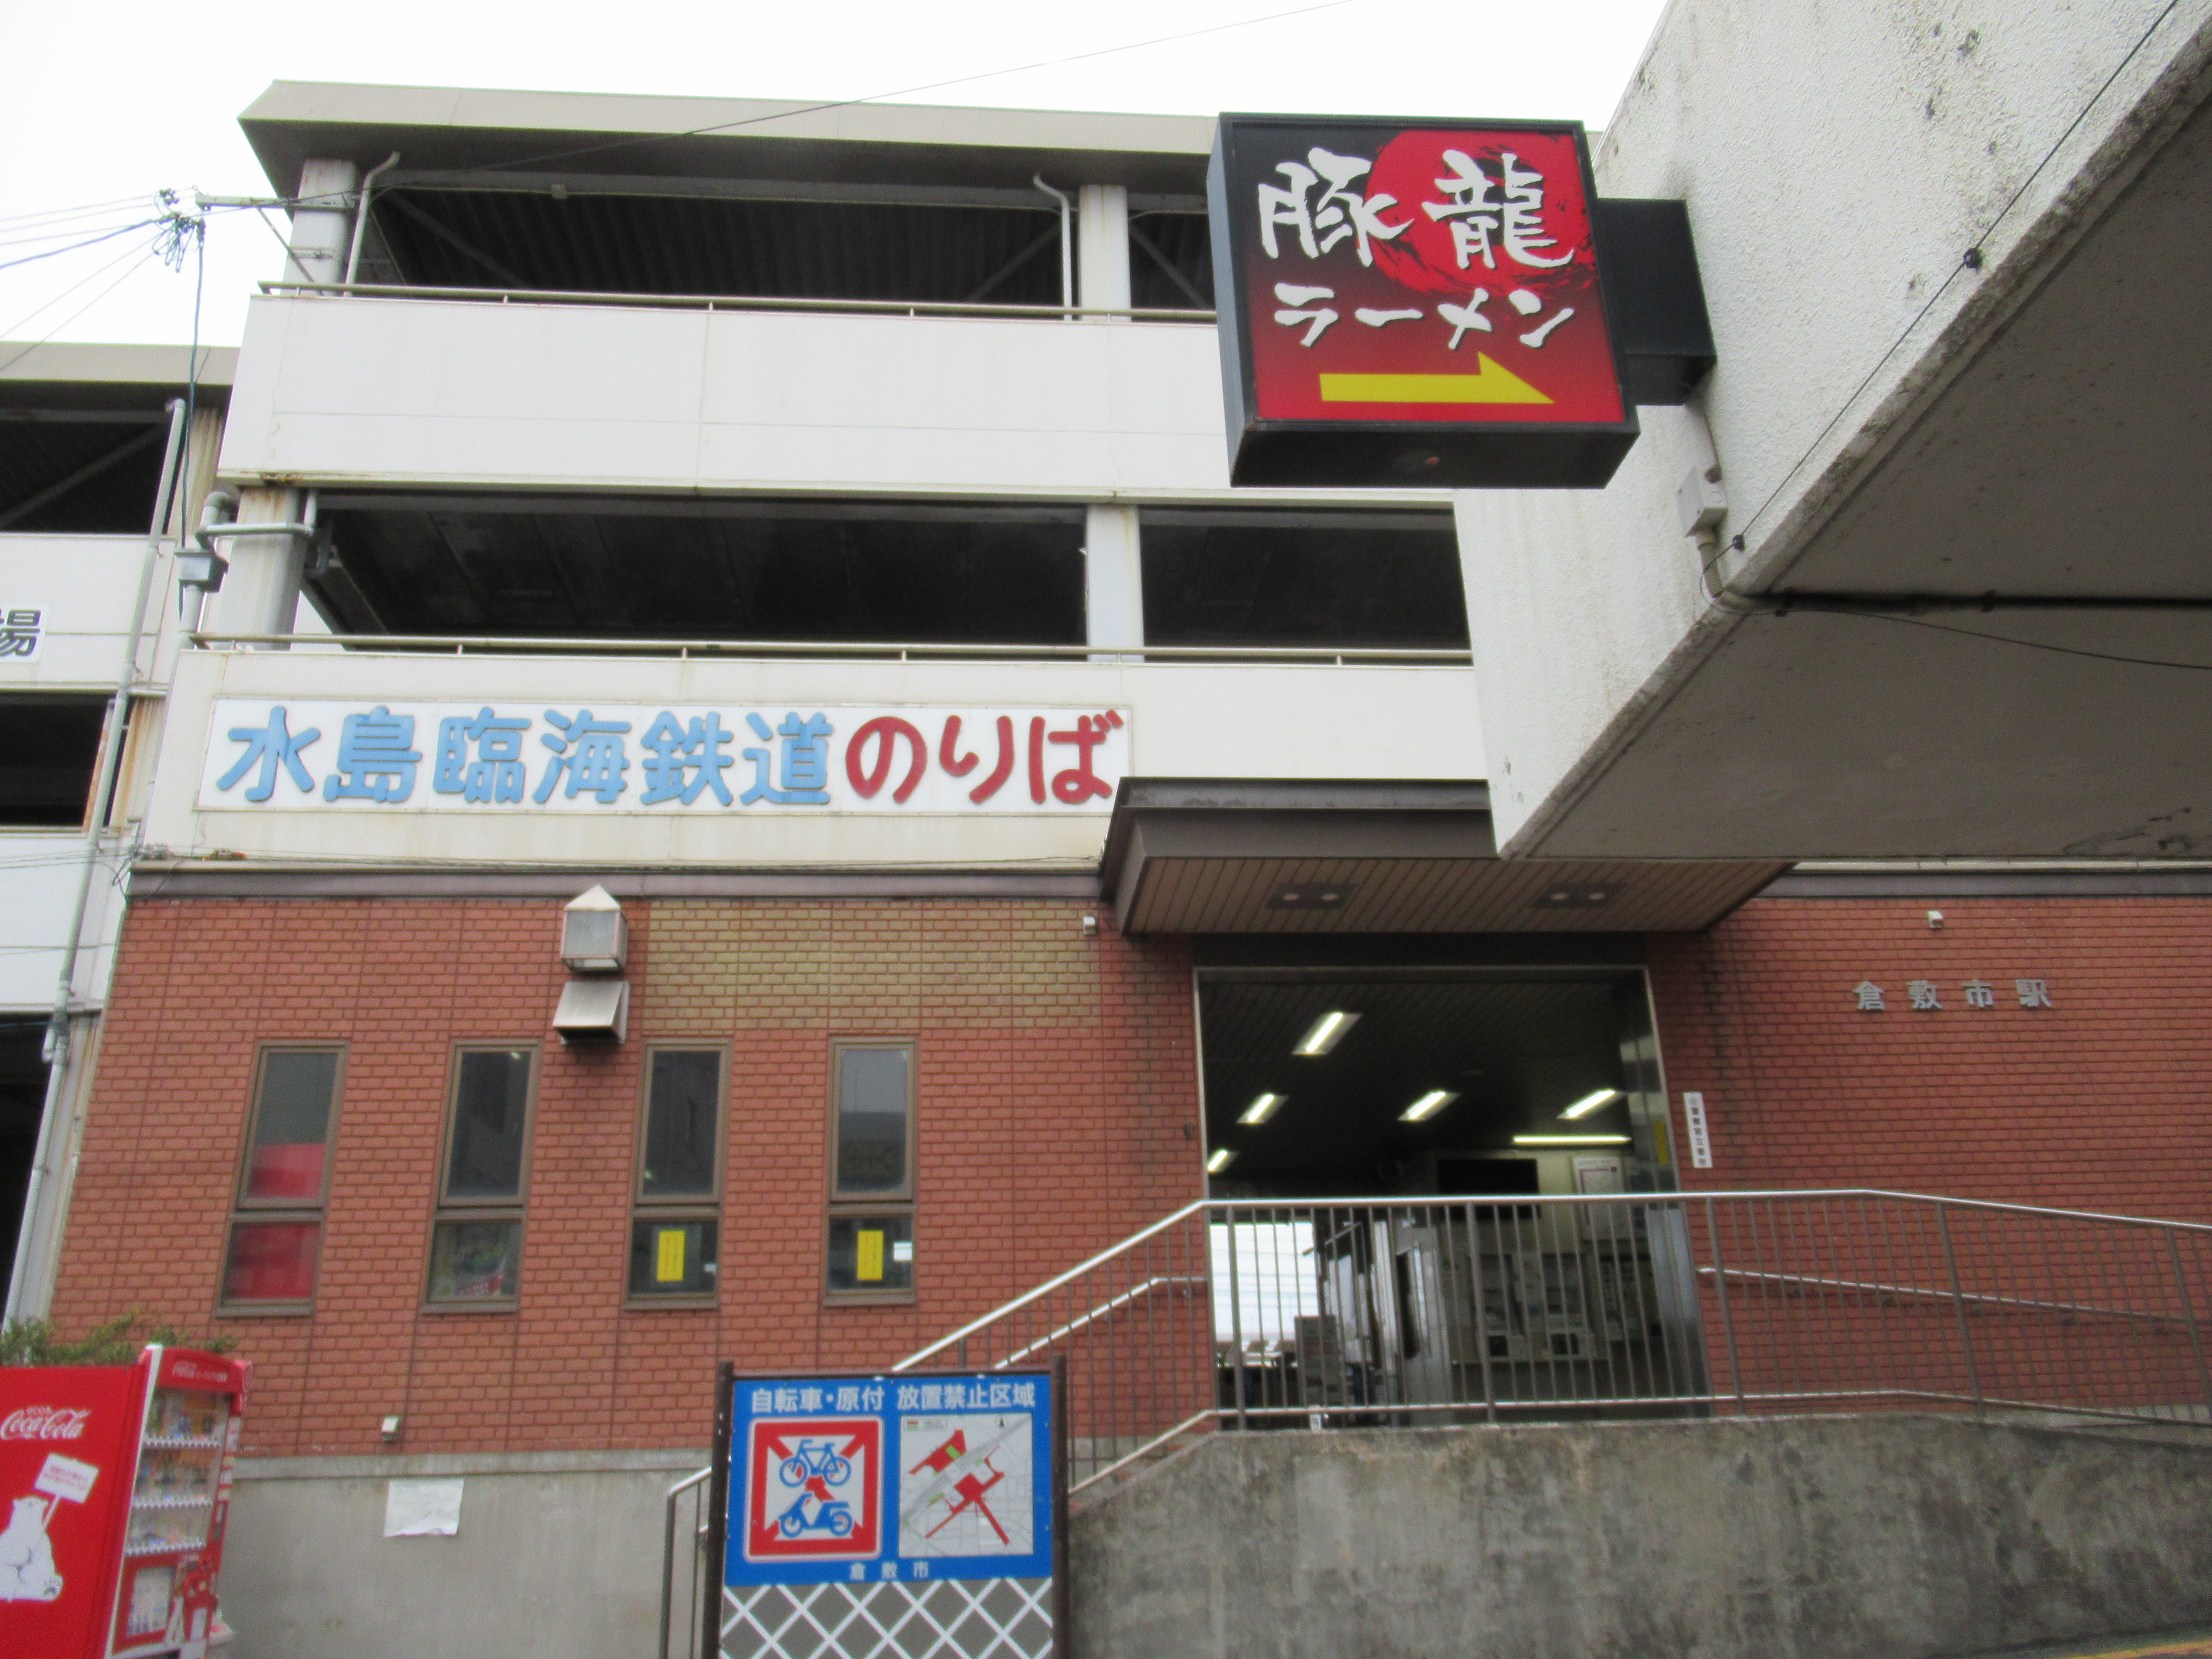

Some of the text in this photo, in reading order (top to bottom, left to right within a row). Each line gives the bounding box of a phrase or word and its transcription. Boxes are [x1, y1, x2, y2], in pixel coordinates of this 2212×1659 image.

[1258, 147, 1575, 269] 豚龍
[1274, 282, 1575, 350] ラーメン
[216, 705, 1124, 805] 水島臨海鉄道のりば
[1853, 979, 2052, 1010] 倉敷市駅
[897, 1382, 1036, 1410] 放置禁止区域
[0, 1409, 92, 1440] Coca-Cola
[850, 1561, 929, 1580] 倉敷市
